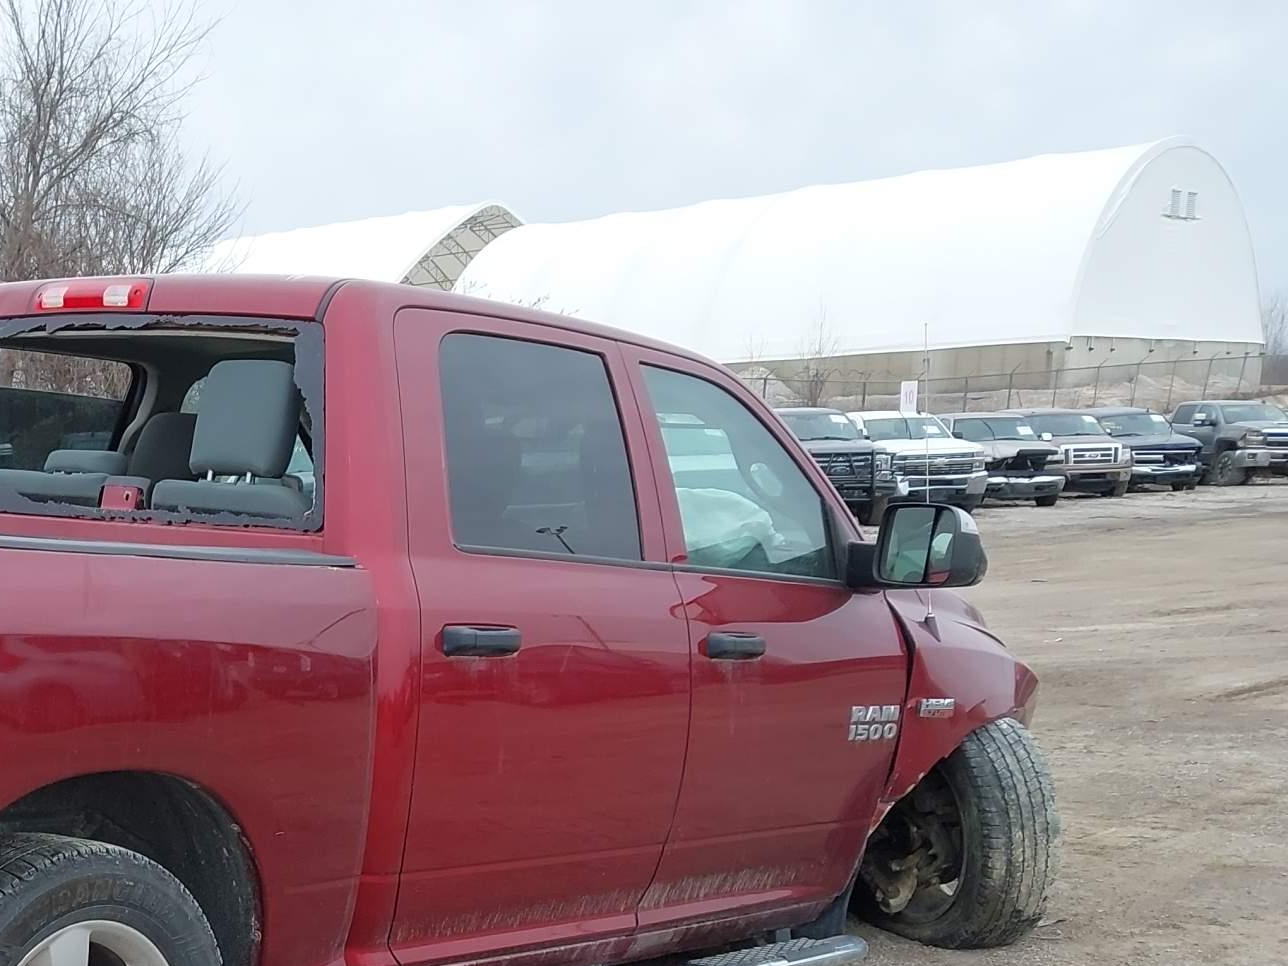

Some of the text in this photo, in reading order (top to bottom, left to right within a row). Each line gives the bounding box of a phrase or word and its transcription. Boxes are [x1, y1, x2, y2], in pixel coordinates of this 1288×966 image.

[905, 390, 915, 405] 10
[851, 705, 900, 721] RAM
[848, 723, 897, 741] 1500
